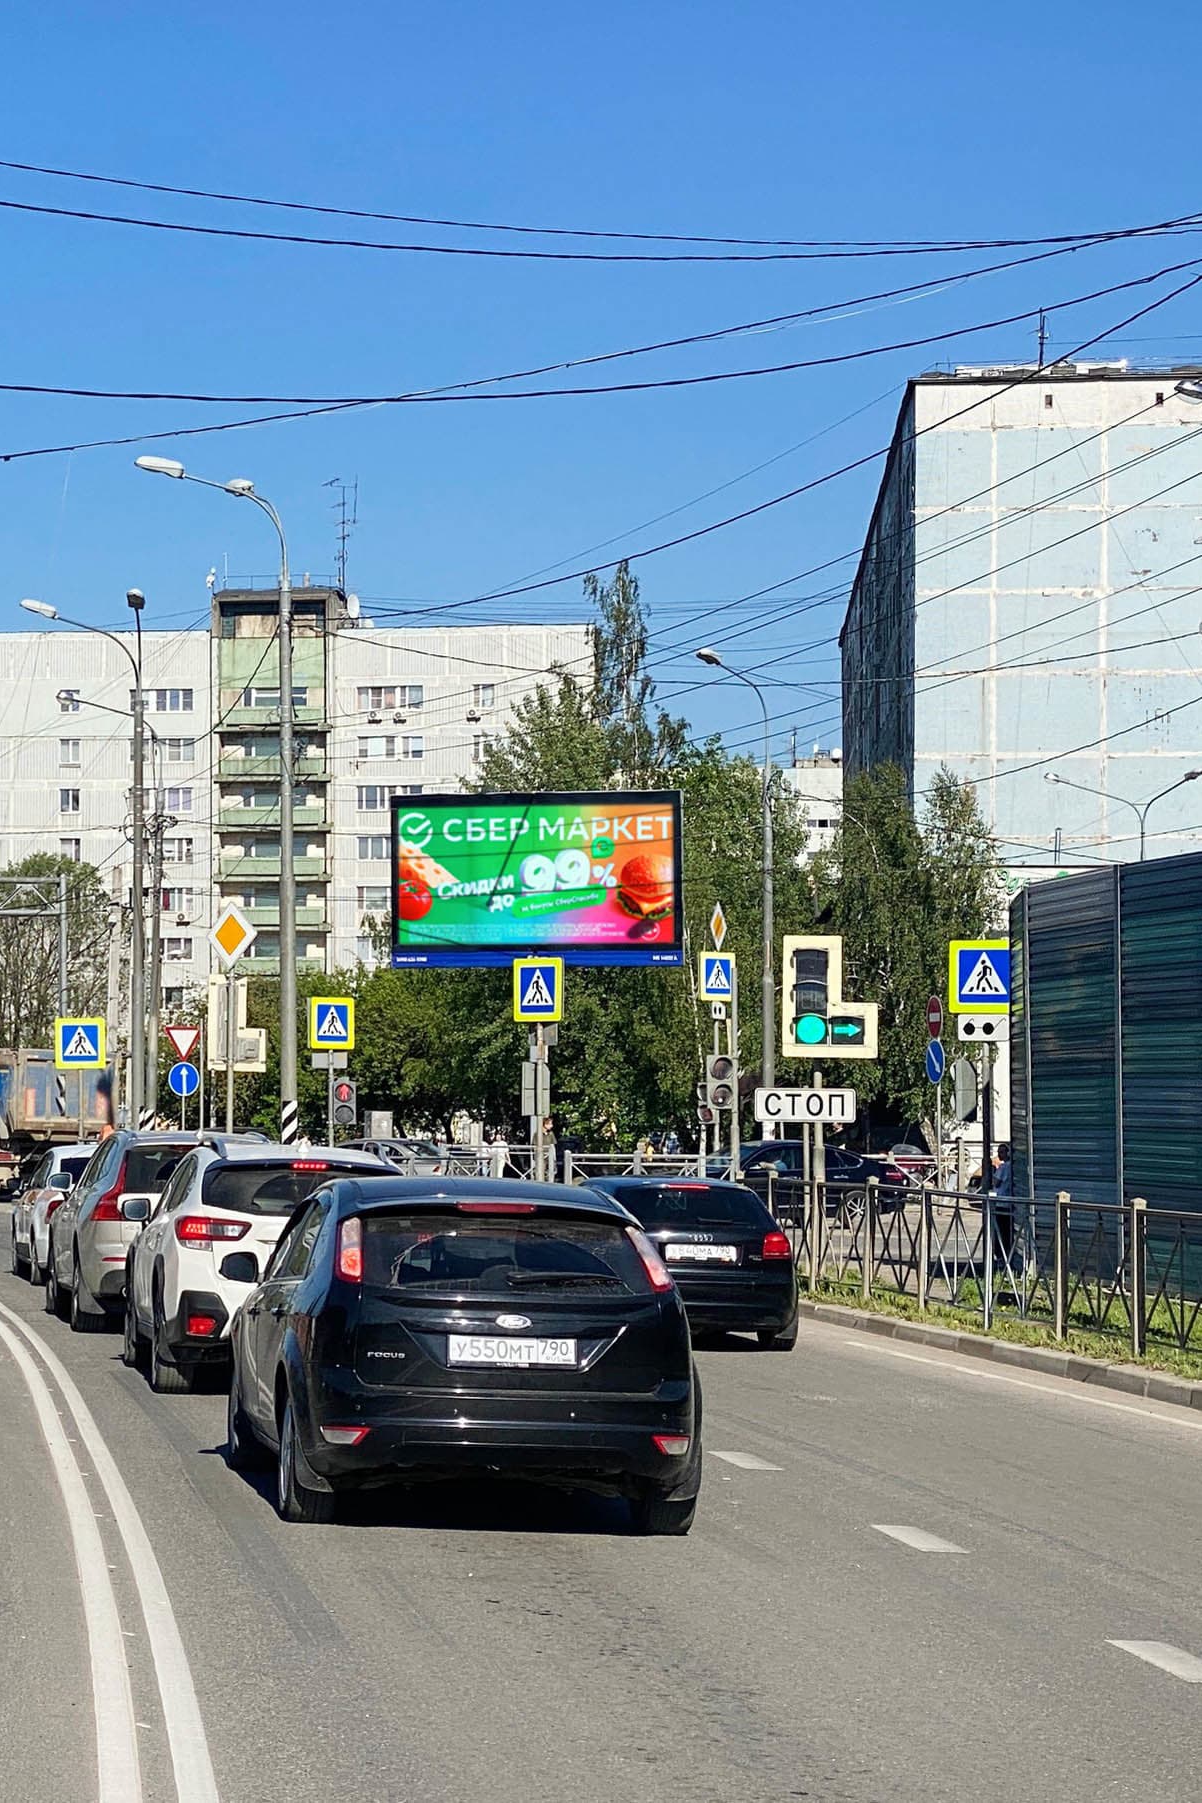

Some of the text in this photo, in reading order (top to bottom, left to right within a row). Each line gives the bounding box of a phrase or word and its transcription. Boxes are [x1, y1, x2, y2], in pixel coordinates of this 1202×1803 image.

[442, 815, 673, 842] СБЕР МАРКЕТ
[437, 874, 516, 899] Скидки
[489, 894, 516, 913] до
[764, 1093, 845, 1116] СТОП
[539, 1340, 569, 1356] 790
